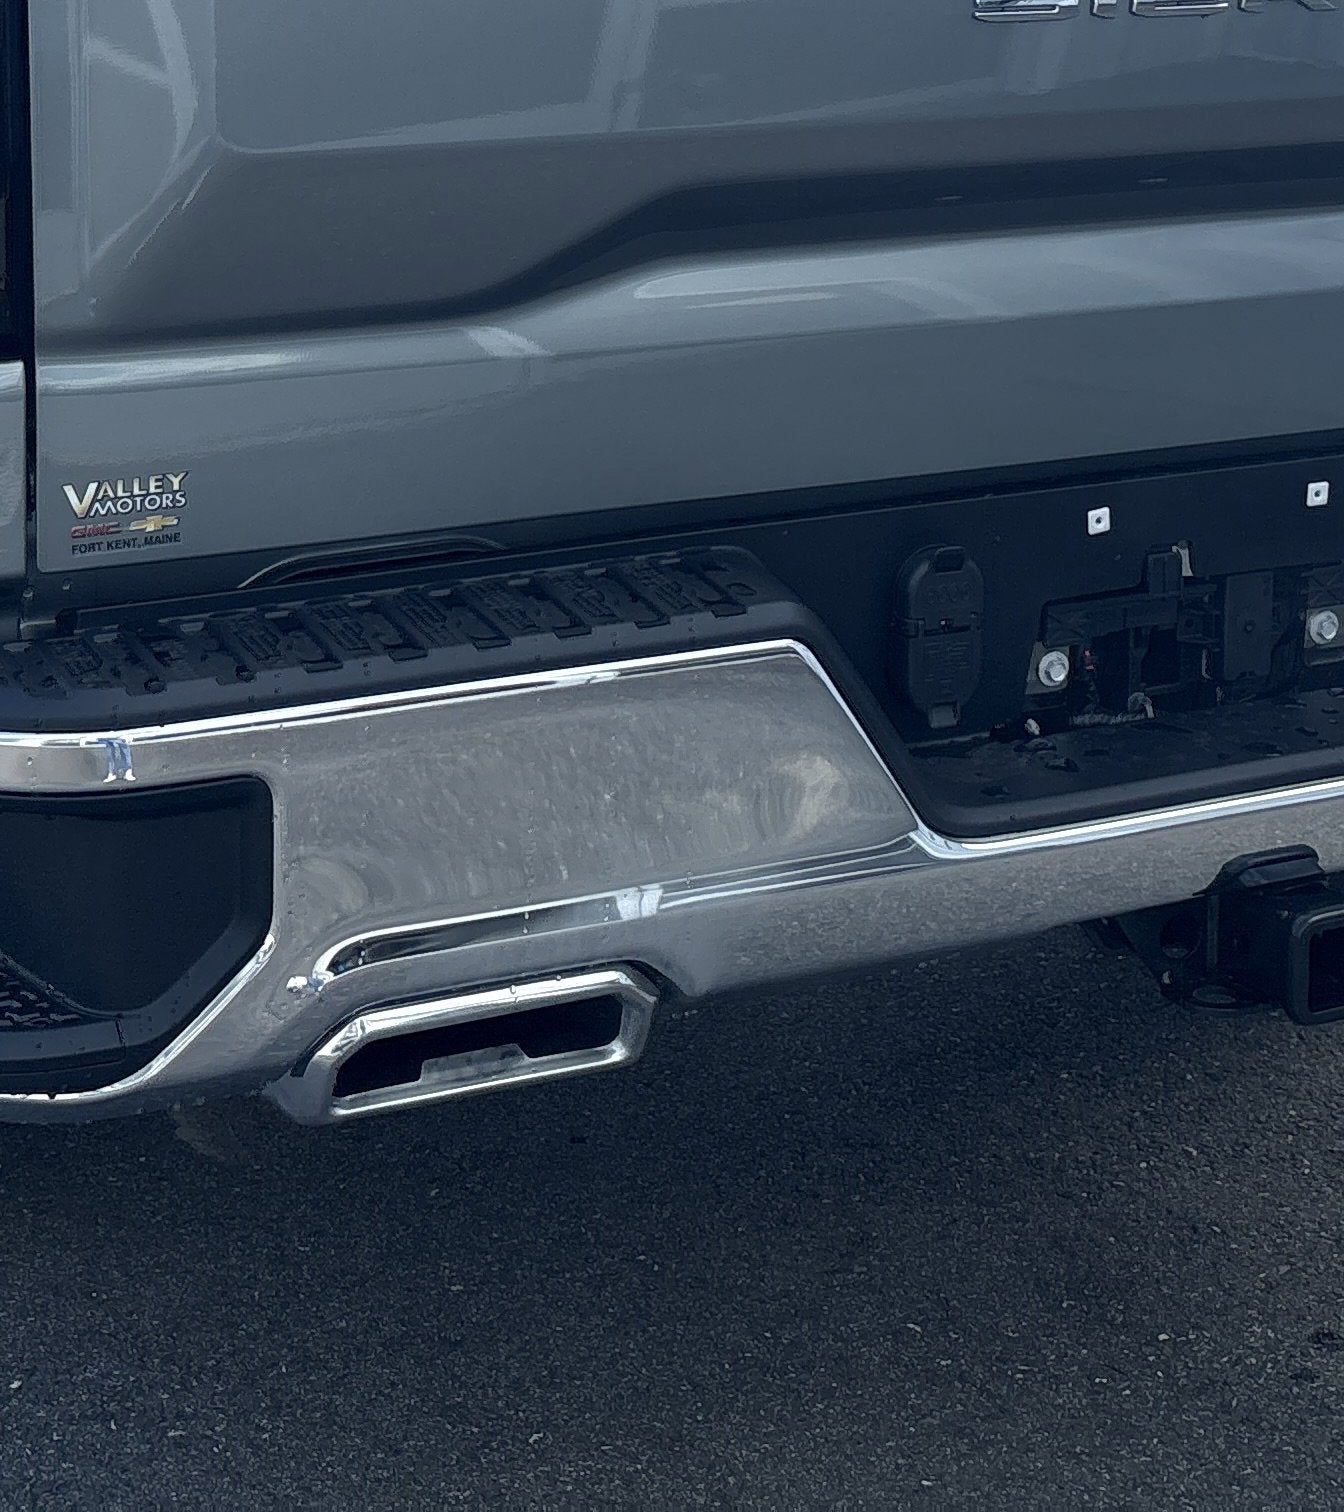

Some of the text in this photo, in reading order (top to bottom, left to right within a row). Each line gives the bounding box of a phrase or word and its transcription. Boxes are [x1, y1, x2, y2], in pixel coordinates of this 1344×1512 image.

[62, 470, 189, 519] VALLEY
[89, 491, 187, 517] MOTORS
[72, 541, 104, 555] FORT
[144, 532, 181, 546] MAINE
